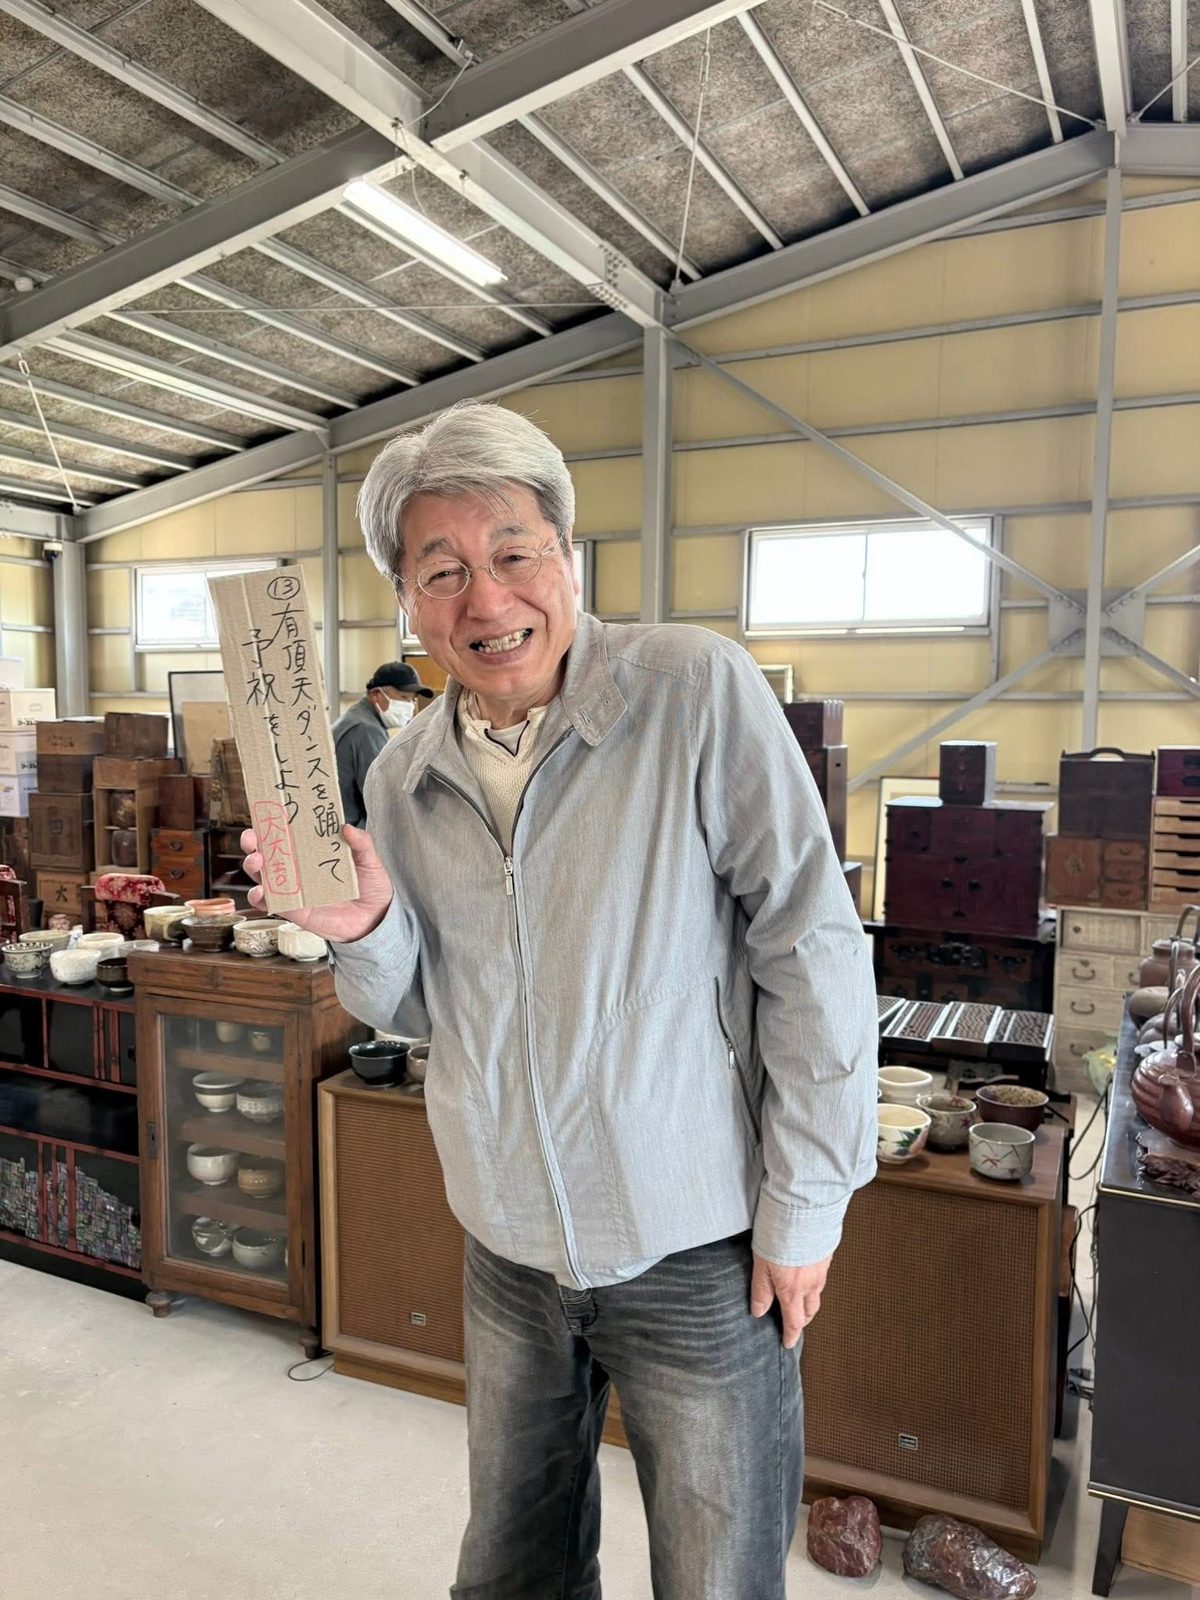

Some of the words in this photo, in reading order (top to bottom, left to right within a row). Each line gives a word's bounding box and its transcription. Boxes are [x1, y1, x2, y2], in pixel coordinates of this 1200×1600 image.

[241, 629, 299, 824] 予祝をしよう
[257, 812, 292, 887] 大大吉
